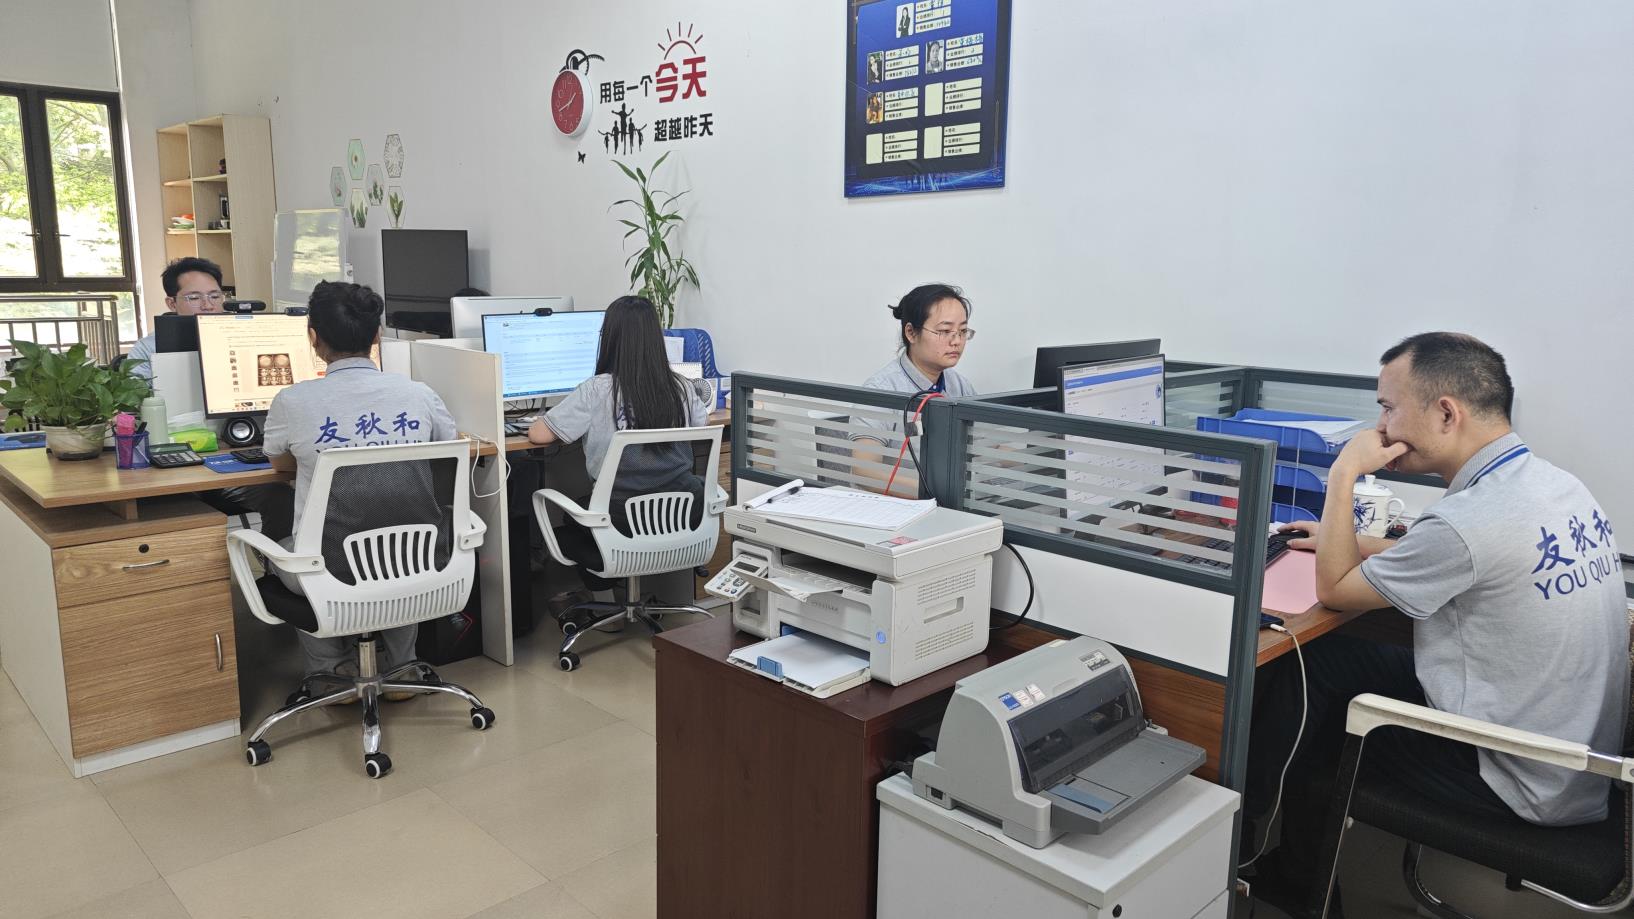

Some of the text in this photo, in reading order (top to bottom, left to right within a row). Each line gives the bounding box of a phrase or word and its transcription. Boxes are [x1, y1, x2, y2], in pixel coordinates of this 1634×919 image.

[654, 113, 713, 142] 超越昨天
[315, 412, 420, 444] 友秋和
[1531, 509, 1613, 574] 友秋和
[1534, 567, 1587, 600] YOU
[1589, 555, 1611, 584] QIU
